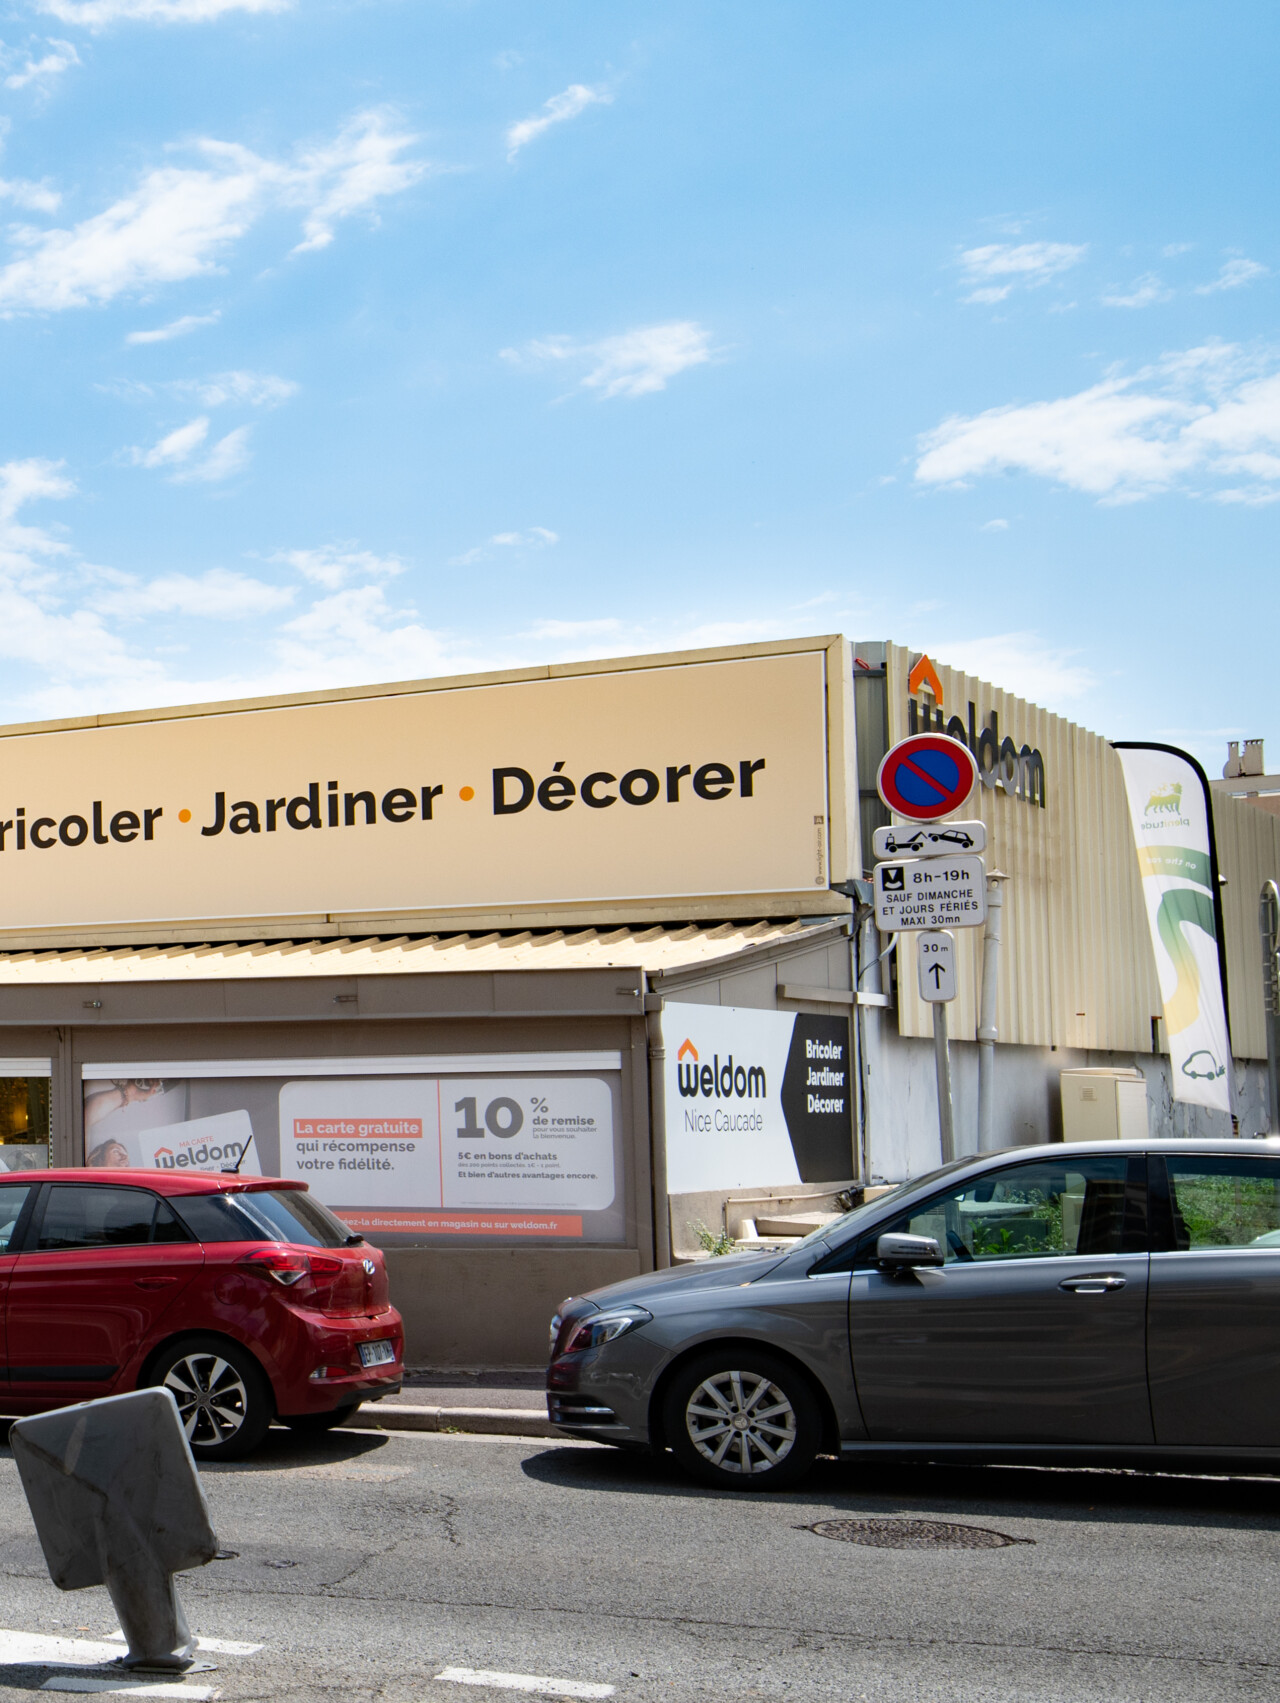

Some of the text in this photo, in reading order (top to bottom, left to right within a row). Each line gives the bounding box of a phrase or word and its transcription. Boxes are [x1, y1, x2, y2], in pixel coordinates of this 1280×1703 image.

[201, 782, 443, 837] Jardiner
[492, 757, 766, 815] Décorer
[913, 870, 970, 883] 8h-19h
[886, 889, 973, 903] SAUF DIMANCHE
[882, 900, 978, 915] ET JOURS FÉRIÉS
[901, 915, 960, 926] MAXI 30mn
[923, 944, 939, 952] 30
[805, 1039, 842, 1060] Bricoler
[677, 1054, 767, 1098] weldom
[806, 1066, 845, 1086] Jardiner
[807, 1093, 844, 1114] Décorer
[532, 1115, 595, 1126] de remise
[684, 1108, 763, 1133] Nice Caucade
[296, 1121, 419, 1137] La carte gratuite
[191, 1136, 214, 1146] CARTE
[296, 1140, 416, 1155] qui récompense
[154, 1142, 244, 1169] weldom
[458, 1152, 471, 1160] 5€
[488, 1152, 512, 1160] bons
[514, 1152, 558, 1161] d'achats
[296, 1158, 395, 1170] votre fidélité.
[487, 1171, 520, 1179] d'autres
[521, 1172, 565, 1180] avantages
[343, 1218, 370, 1226] éez-la
[371, 1218, 426, 1227] directement
[440, 1219, 479, 1229] magasin
[510, 1220, 558, 1230] weldom.fr
